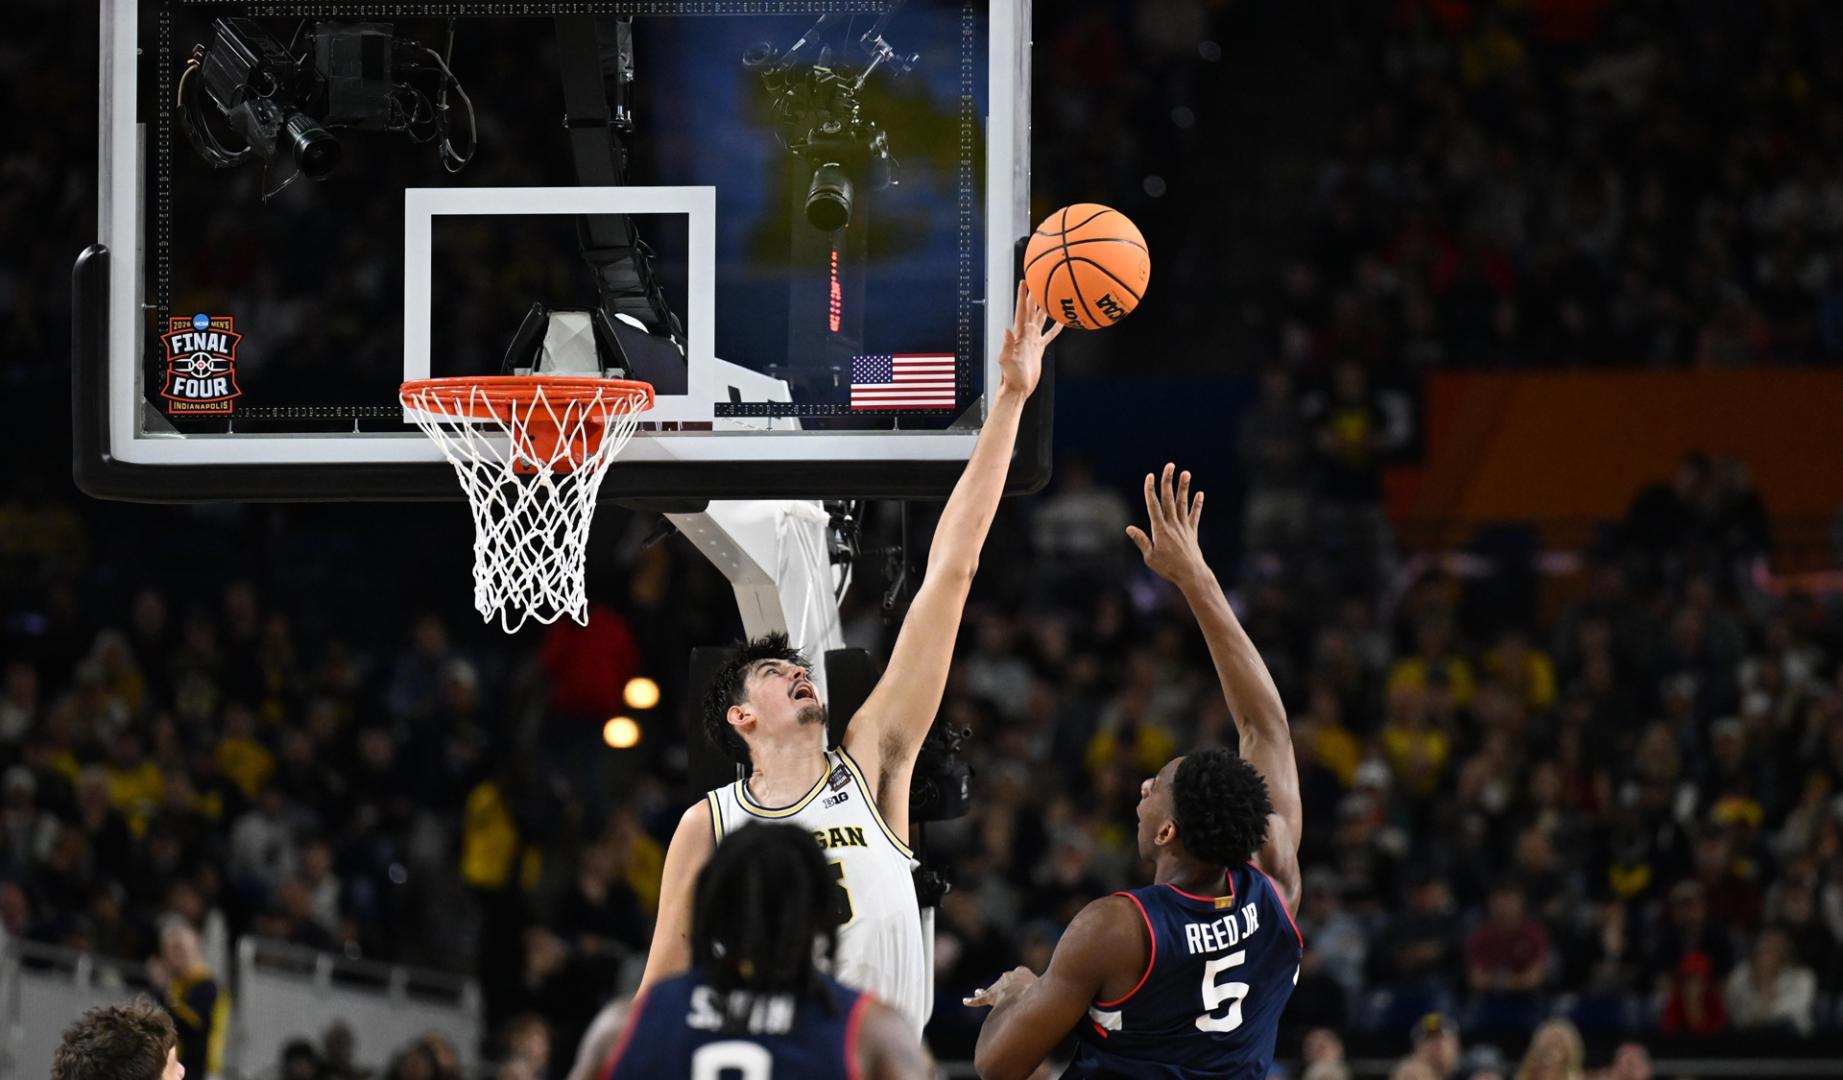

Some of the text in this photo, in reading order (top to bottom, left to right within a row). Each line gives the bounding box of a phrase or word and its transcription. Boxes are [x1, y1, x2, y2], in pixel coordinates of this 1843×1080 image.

[211, 321, 230, 329] MEN'S
[171, 333, 228, 354] FINAL
[173, 377, 228, 398] FOUR
[174, 401, 228, 410] INDIANAPOLIS
[815, 827, 868, 850] GAN
[1185, 902, 1260, 955] REED JR
[1195, 949, 1250, 1032] 5
